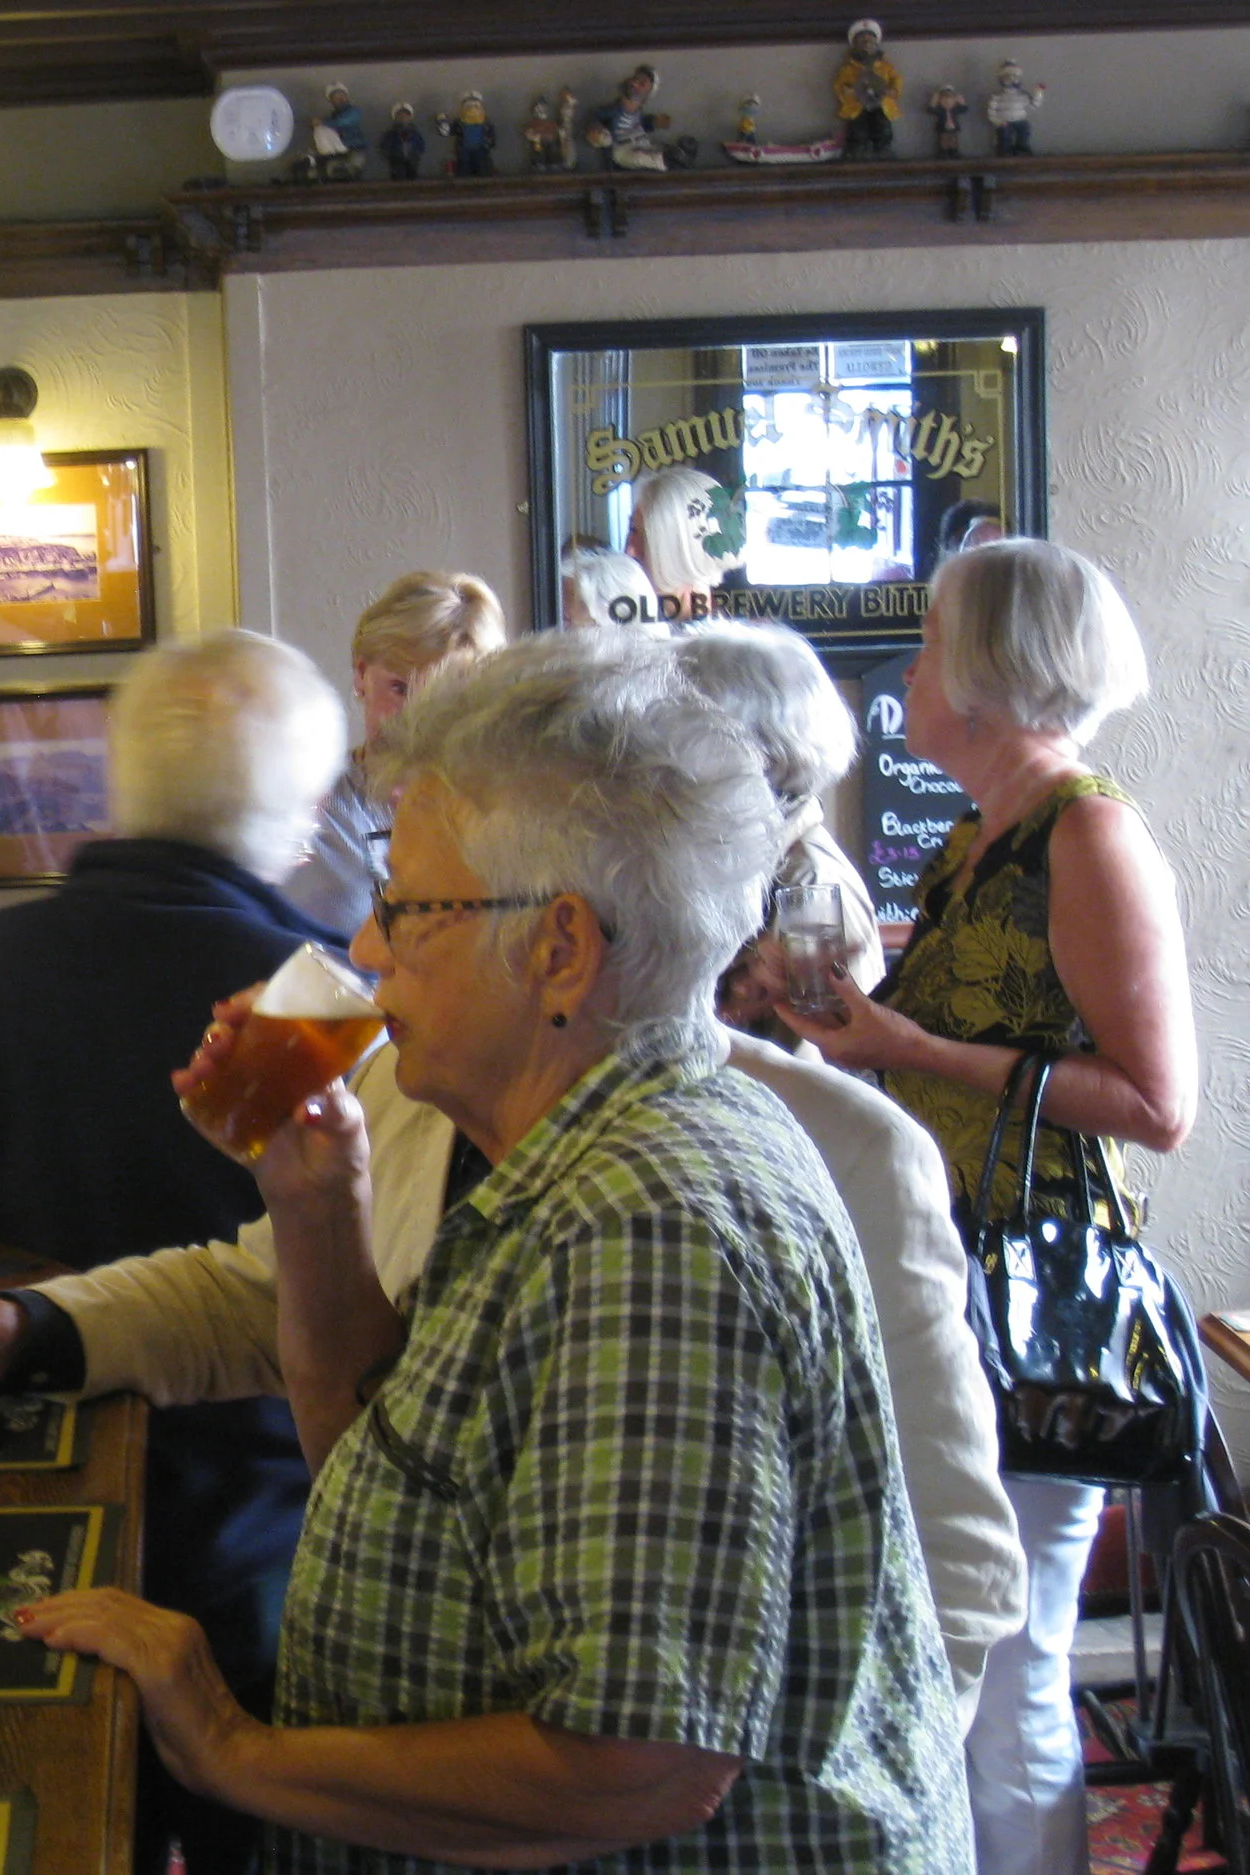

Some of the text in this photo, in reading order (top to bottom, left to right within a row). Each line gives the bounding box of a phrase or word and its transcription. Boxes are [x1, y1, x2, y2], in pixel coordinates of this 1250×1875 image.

[586, 384, 994, 496] Samuel Smith's
[608, 583, 932, 624] OLD BREWERY BITT
[881, 811, 954, 836] Blackber
